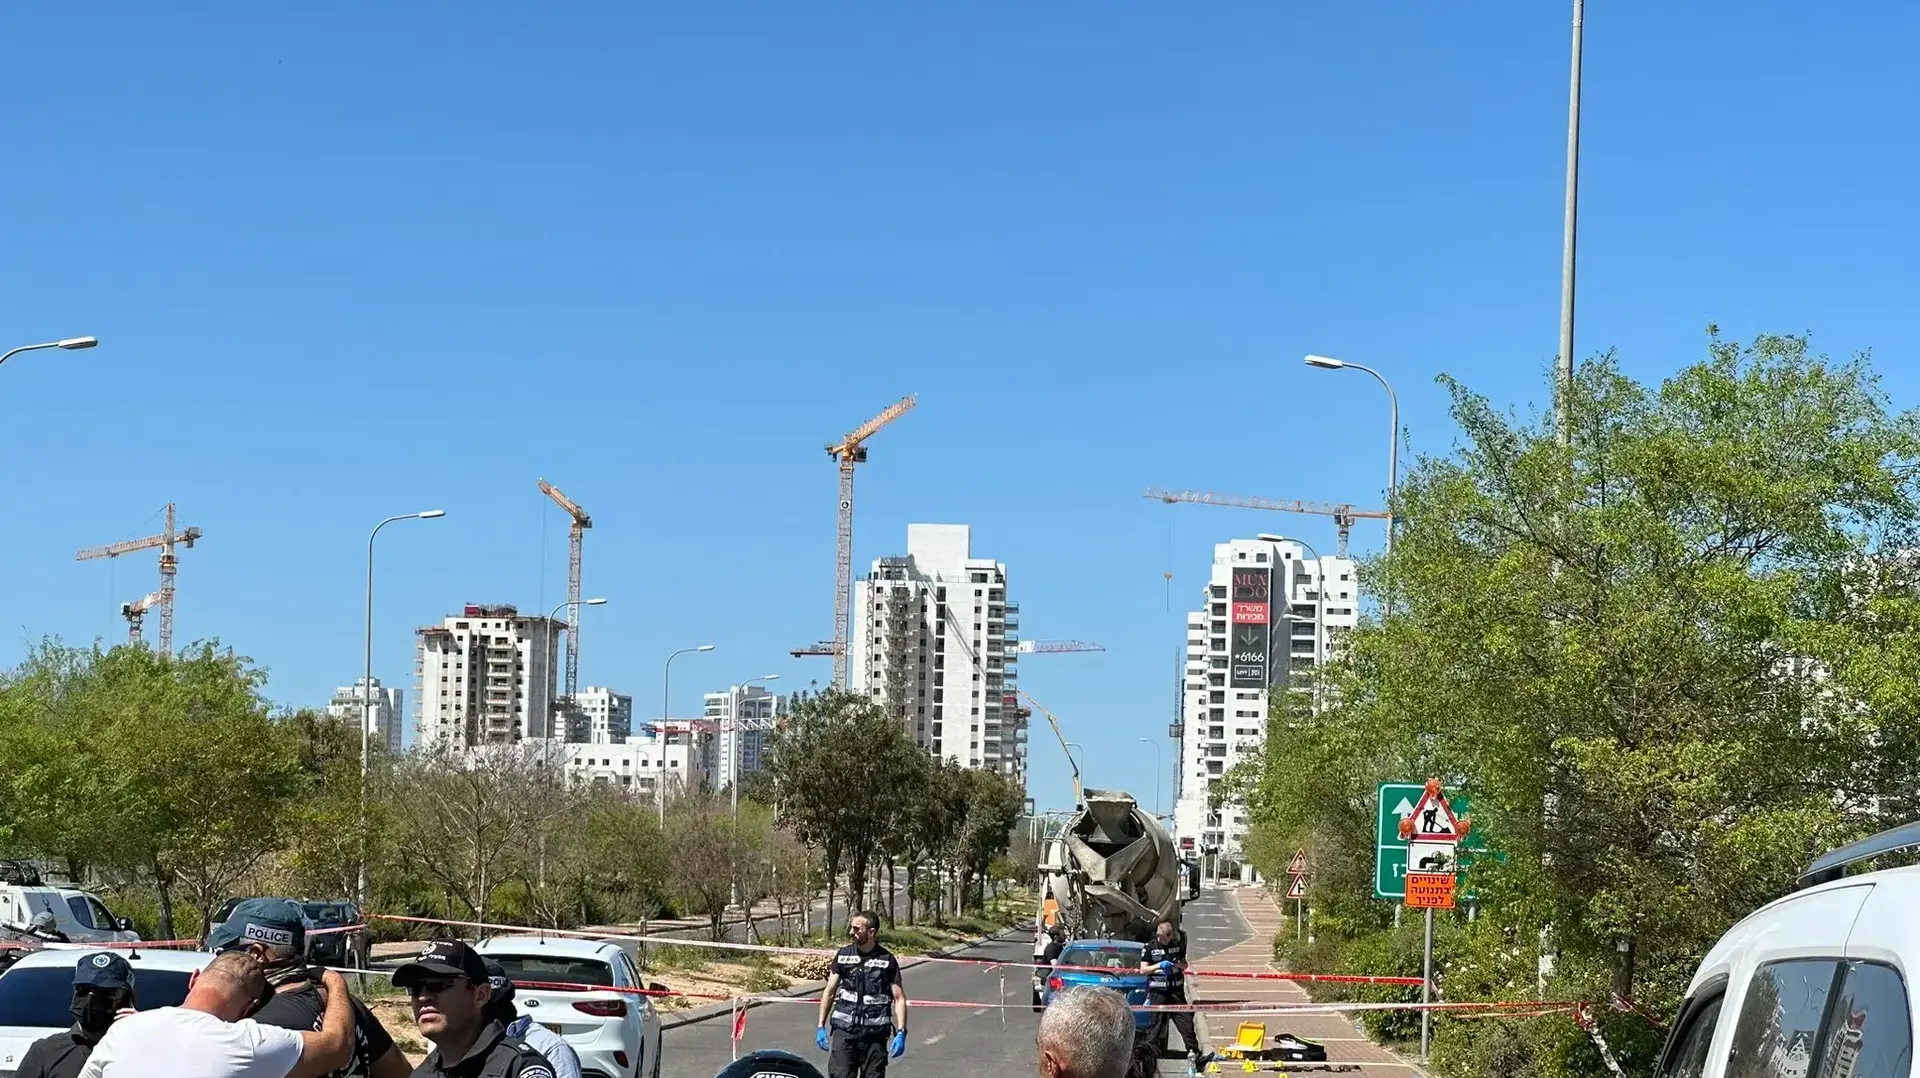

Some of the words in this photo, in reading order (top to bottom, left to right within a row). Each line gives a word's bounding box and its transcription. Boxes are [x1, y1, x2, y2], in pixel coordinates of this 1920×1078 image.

[1233, 574, 1267, 585] MUN
[1411, 876, 1450, 884] שינויים
[1411, 886, 1451, 894] בתנועה
[1416, 895, 1445, 905] לפניך
[248, 927, 290, 942] POLICE
